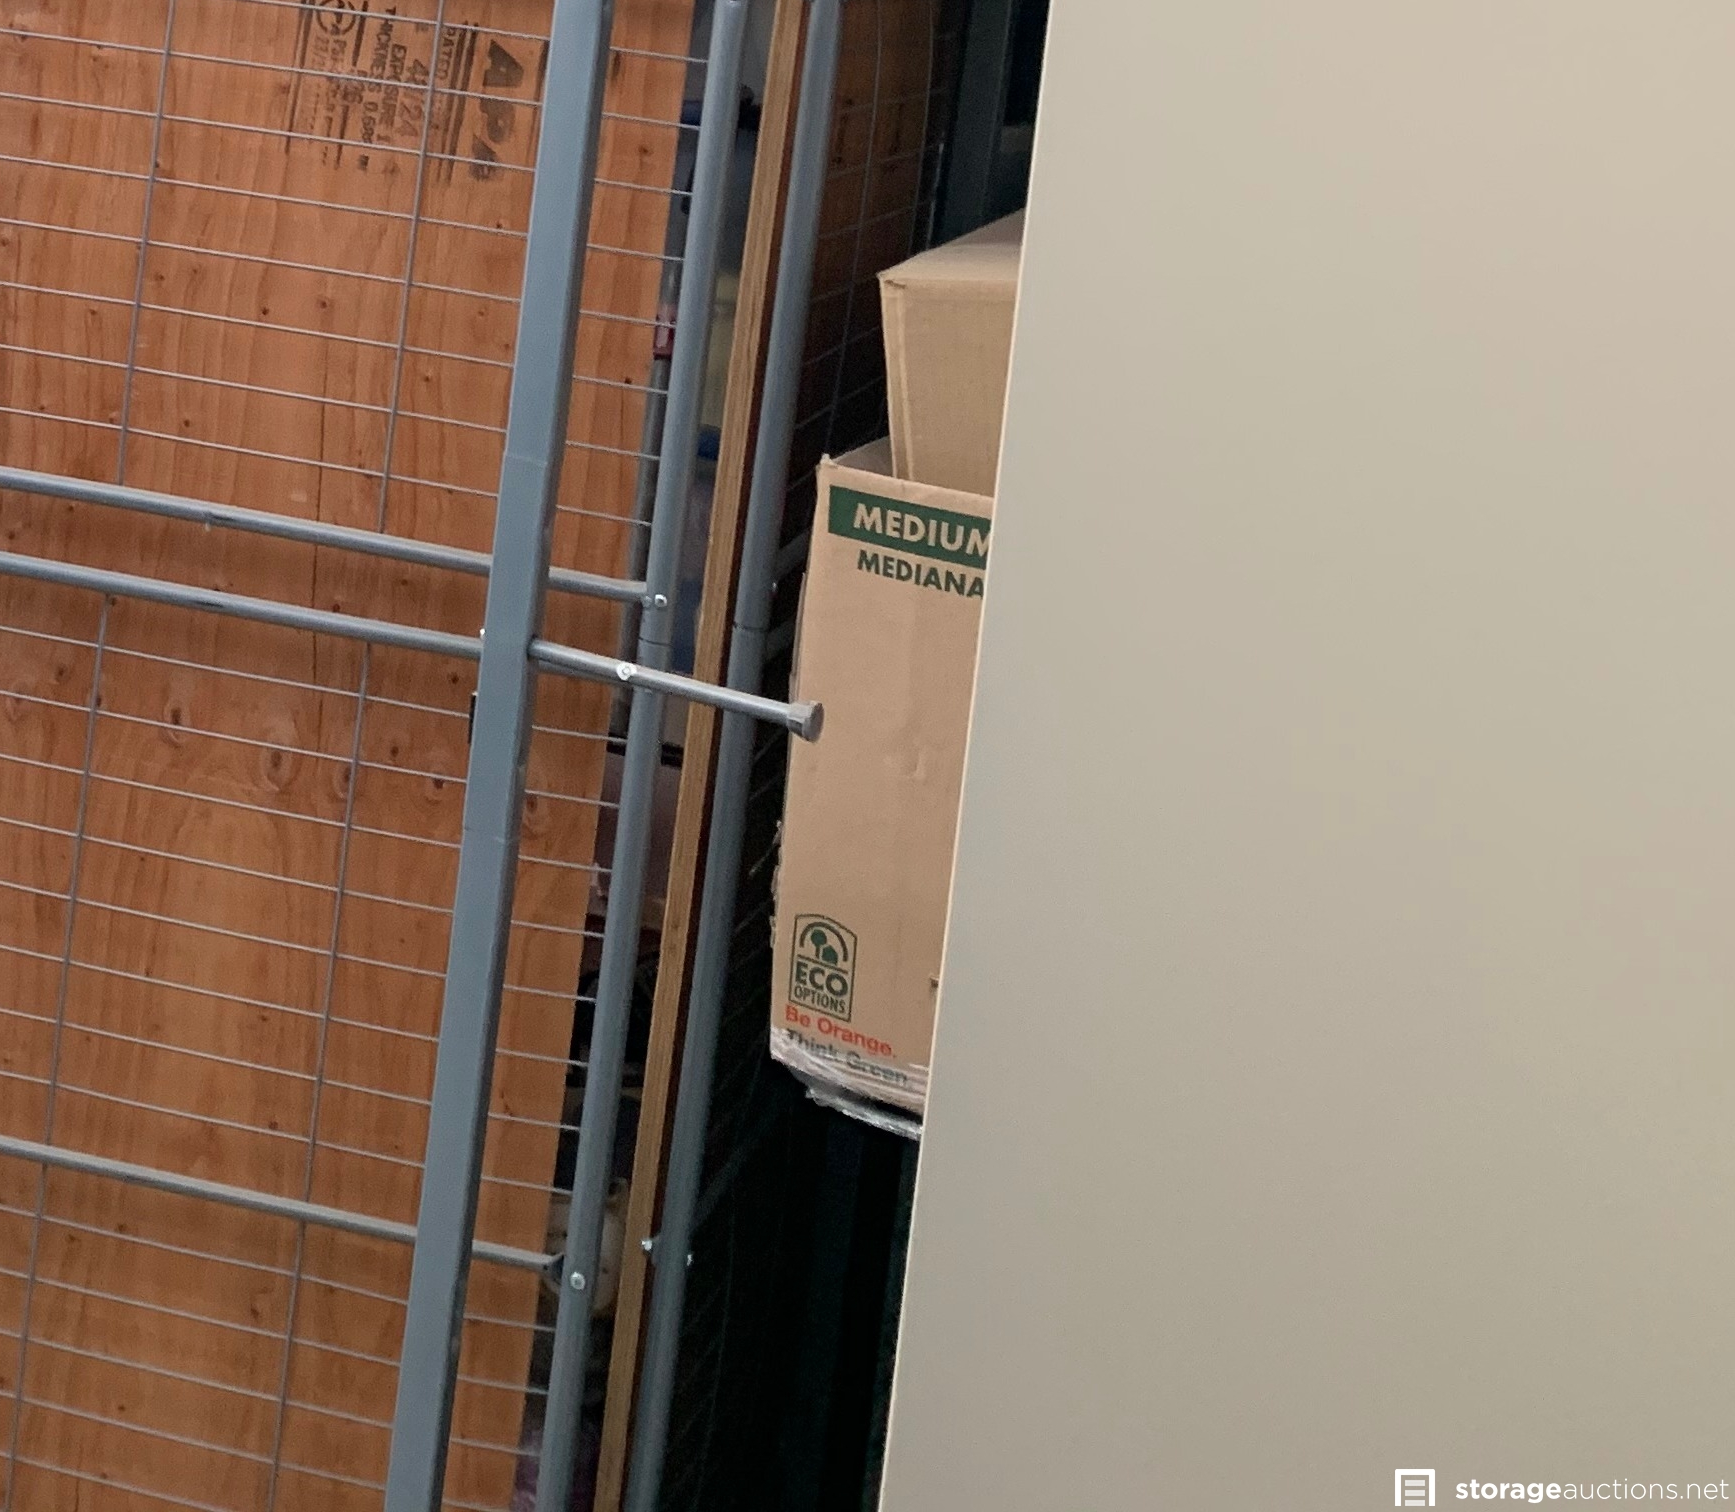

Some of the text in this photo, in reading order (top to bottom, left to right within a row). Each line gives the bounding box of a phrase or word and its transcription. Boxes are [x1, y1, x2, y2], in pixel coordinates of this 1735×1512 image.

[469, 39, 524, 180] APA
[853, 502, 993, 558] MEDIUM
[856, 549, 985, 600] MEDIANA
[794, 986, 846, 1015] OPTIONS
[795, 960, 849, 997] ECO
[785, 1004, 897, 1059] Be Orange.
